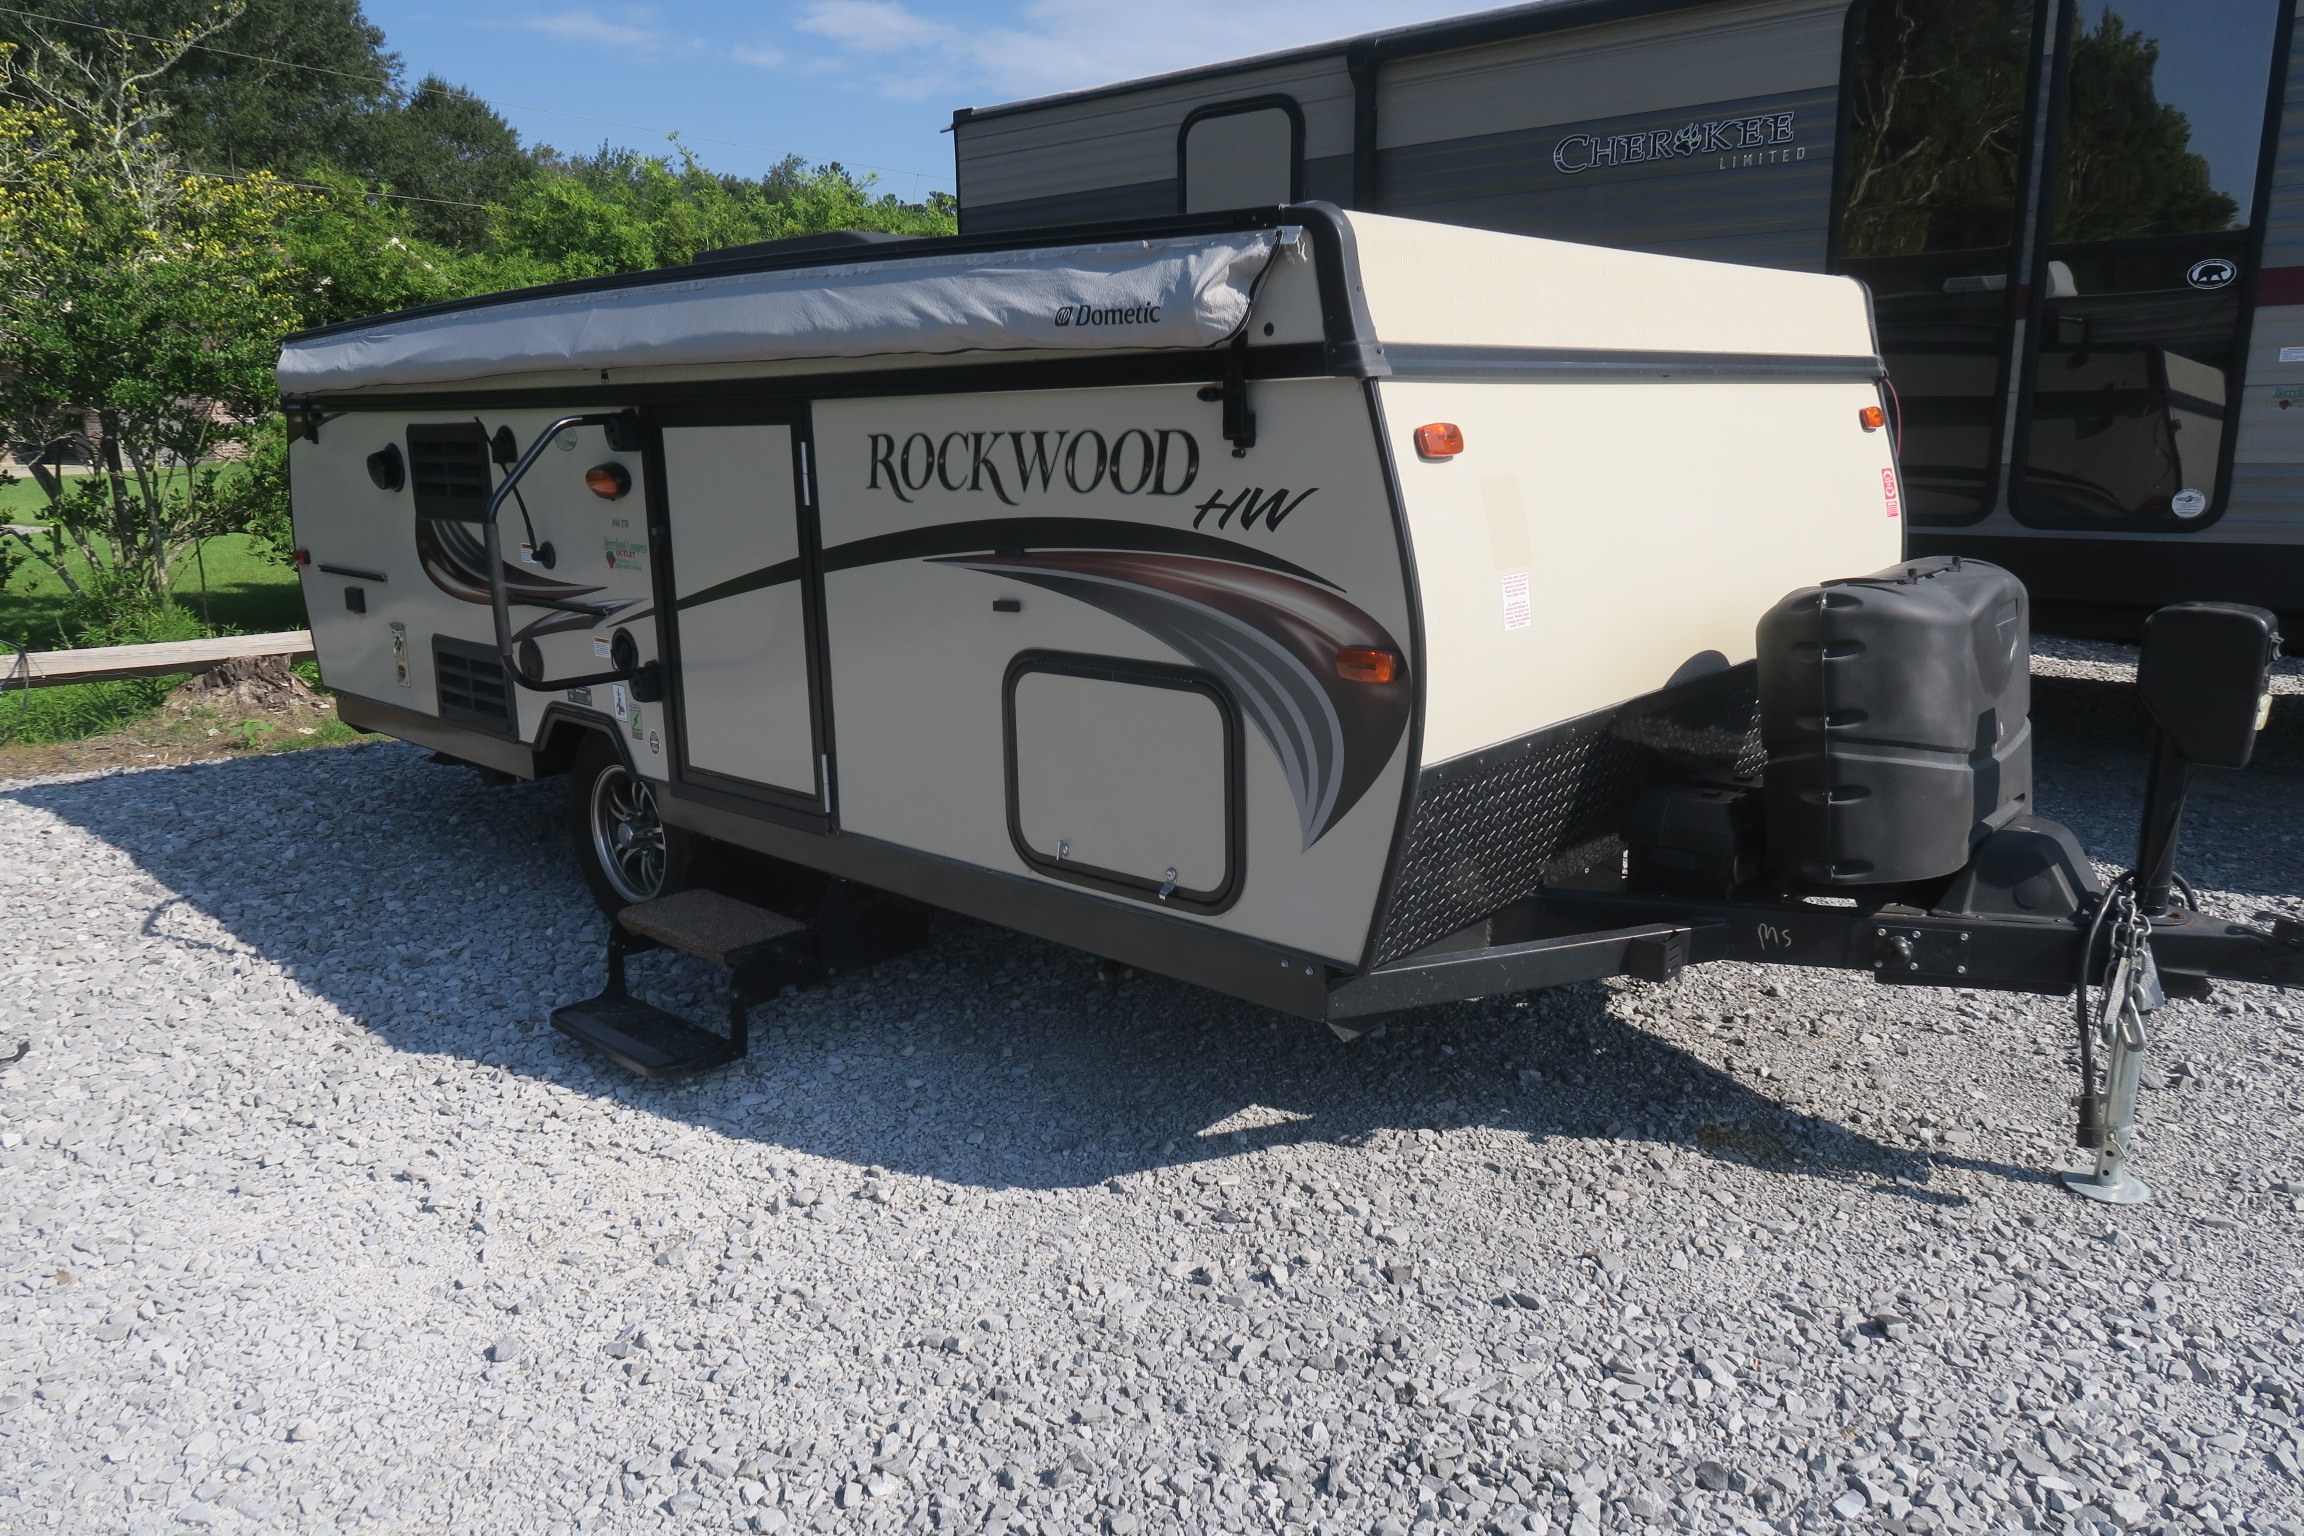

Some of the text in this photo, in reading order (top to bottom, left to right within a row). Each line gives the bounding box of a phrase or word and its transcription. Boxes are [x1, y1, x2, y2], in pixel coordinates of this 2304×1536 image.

[1553, 112, 1795, 175] CHEROKEE
[1719, 148, 1806, 170] LIMITED
[1075, 301, 1161, 326] Dometic
[866, 429, 1200, 505] ROCKWOOD
[1193, 487, 1320, 533] HW
[615, 549, 636, 559] OUTLET
